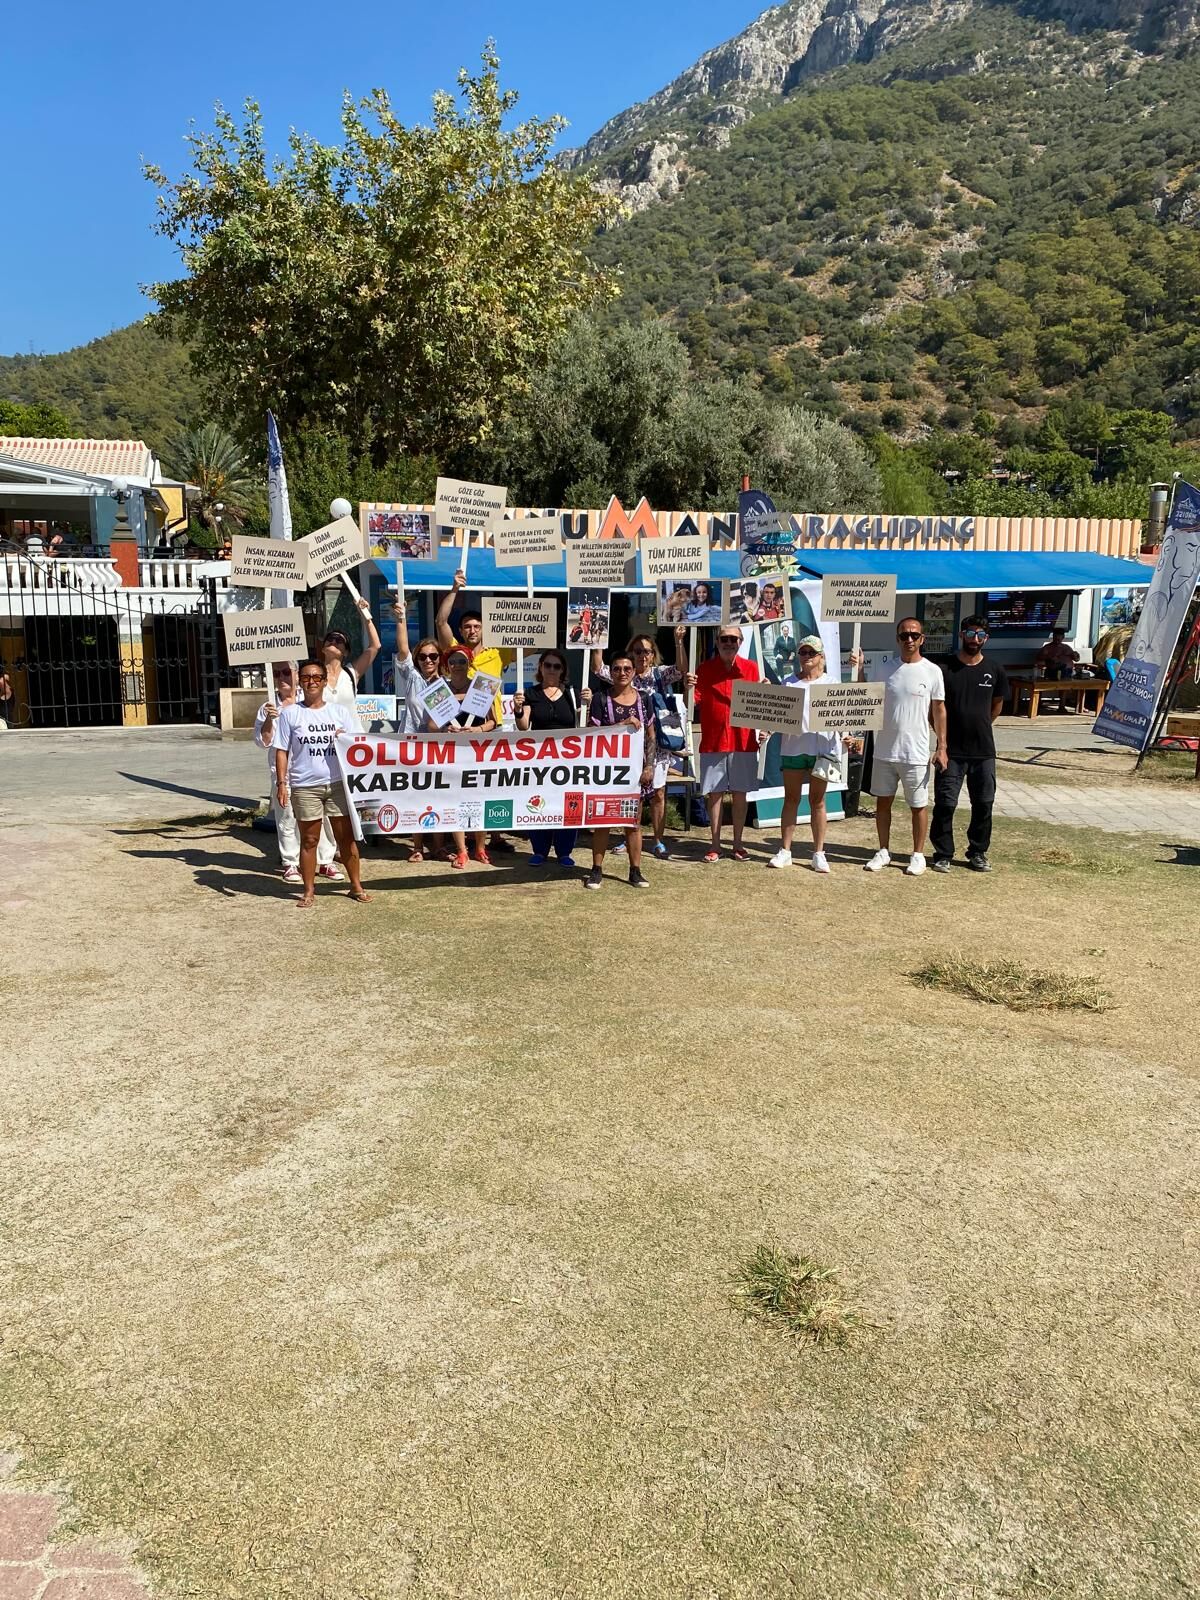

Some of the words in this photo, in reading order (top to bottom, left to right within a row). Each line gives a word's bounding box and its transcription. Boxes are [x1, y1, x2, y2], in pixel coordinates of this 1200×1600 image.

[458, 486, 473, 496] GÖZE
[474, 488, 485, 498] GÖZ
[440, 494, 459, 503] ANCAK
[460, 496, 472, 505] TÜM
[473, 498, 501, 509] DÜNYANIN
[462, 508, 490, 518] OLMASINA
[451, 516, 469, 525] NEDEN
[786, 514, 976, 542] RAGLIDING
[315, 532, 330, 544] İDAM
[267, 550, 295, 559] KIZARAN
[322, 548, 345, 565] ÇÖZÜME
[648, 548, 665, 559] TÜM
[667, 547, 701, 558] TÜRLERE
[266, 560, 295, 569] KIZARTICI
[315, 558, 349, 580] İHTİYACIMIZ
[648, 564, 676, 575] YAŞAM
[677, 562, 702, 572] HAKKI
[252, 569, 272, 577] YAPAN
[870, 581, 888, 589] KARŞI
[496, 600, 532, 610] DÜNYANIN
[489, 613, 522, 621] TEHLİKELİ
[524, 614, 549, 622] CANLISI
[235, 625, 258, 637] ÖLÜM
[260, 624, 294, 634] YASASINI
[491, 624, 526, 634] KÖPEKLER
[527, 625, 546, 634] DEĞİL
[230, 641, 256, 652] KABUL
[257, 636, 302, 650] ETMİYORUZ.
[502, 636, 536, 646] İNSANDIR.
[811, 699, 828, 708] GÖRE
[829, 699, 846, 707] KEYFİ
[847, 698, 882, 706] ÖLDÜRÜLEN
[845, 708, 875, 716] AHİRETTE
[308, 723, 335, 732] ÖLÜM
[309, 748, 337, 756] HAYIR
[346, 735, 456, 767] ÖLÜM
[469, 734, 630, 762] YASASINI
[347, 771, 450, 794] KABUL
[488, 809, 509, 818] Dodo
[517, 815, 563, 823] DOHAKDER
